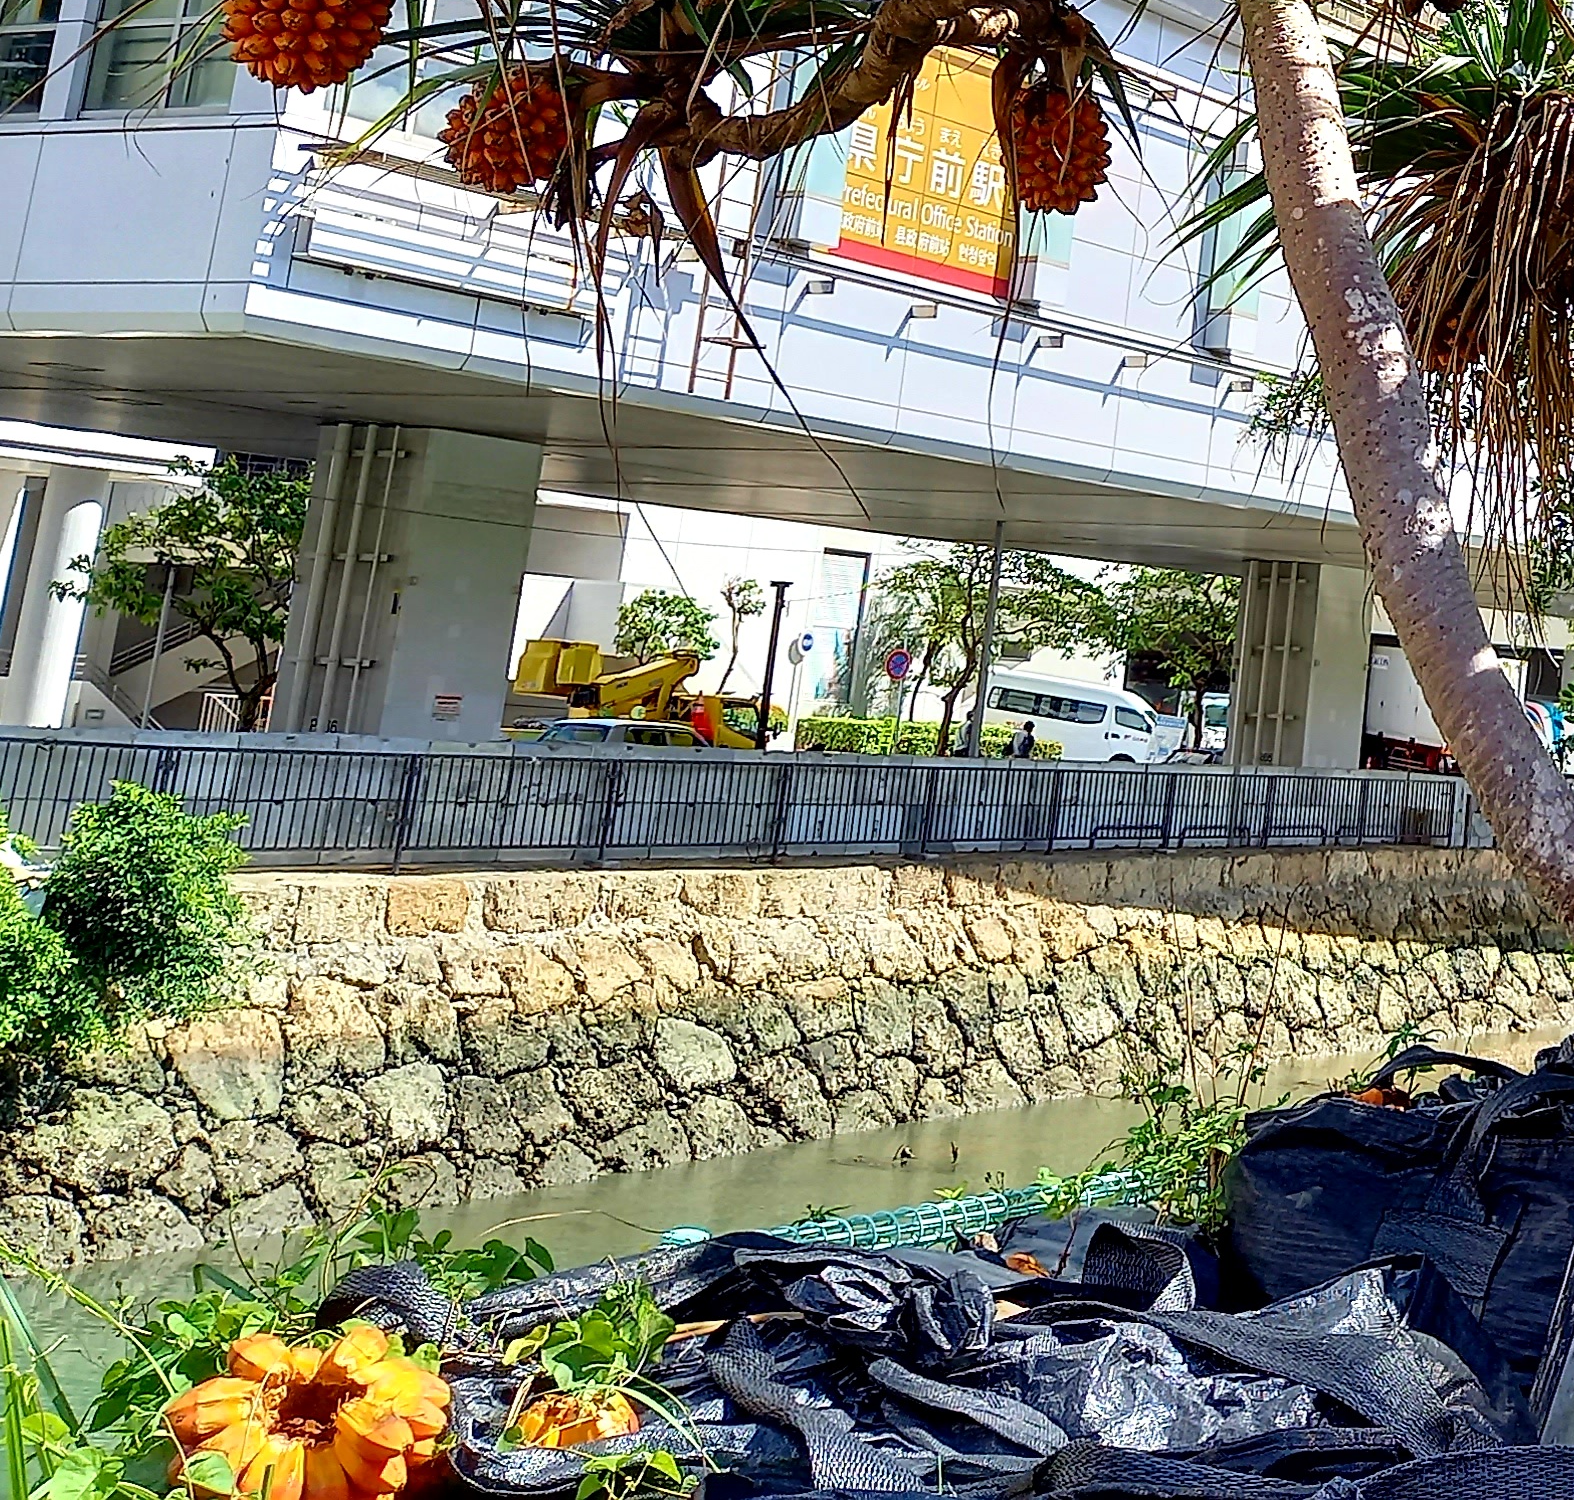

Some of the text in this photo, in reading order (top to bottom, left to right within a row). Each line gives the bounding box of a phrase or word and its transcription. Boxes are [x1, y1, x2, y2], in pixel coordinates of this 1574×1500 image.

[848, 122, 1012, 213] 県庁前駅
[940, 127, 962, 149] まえ
[843, 182, 1013, 247] refecural Office Station
